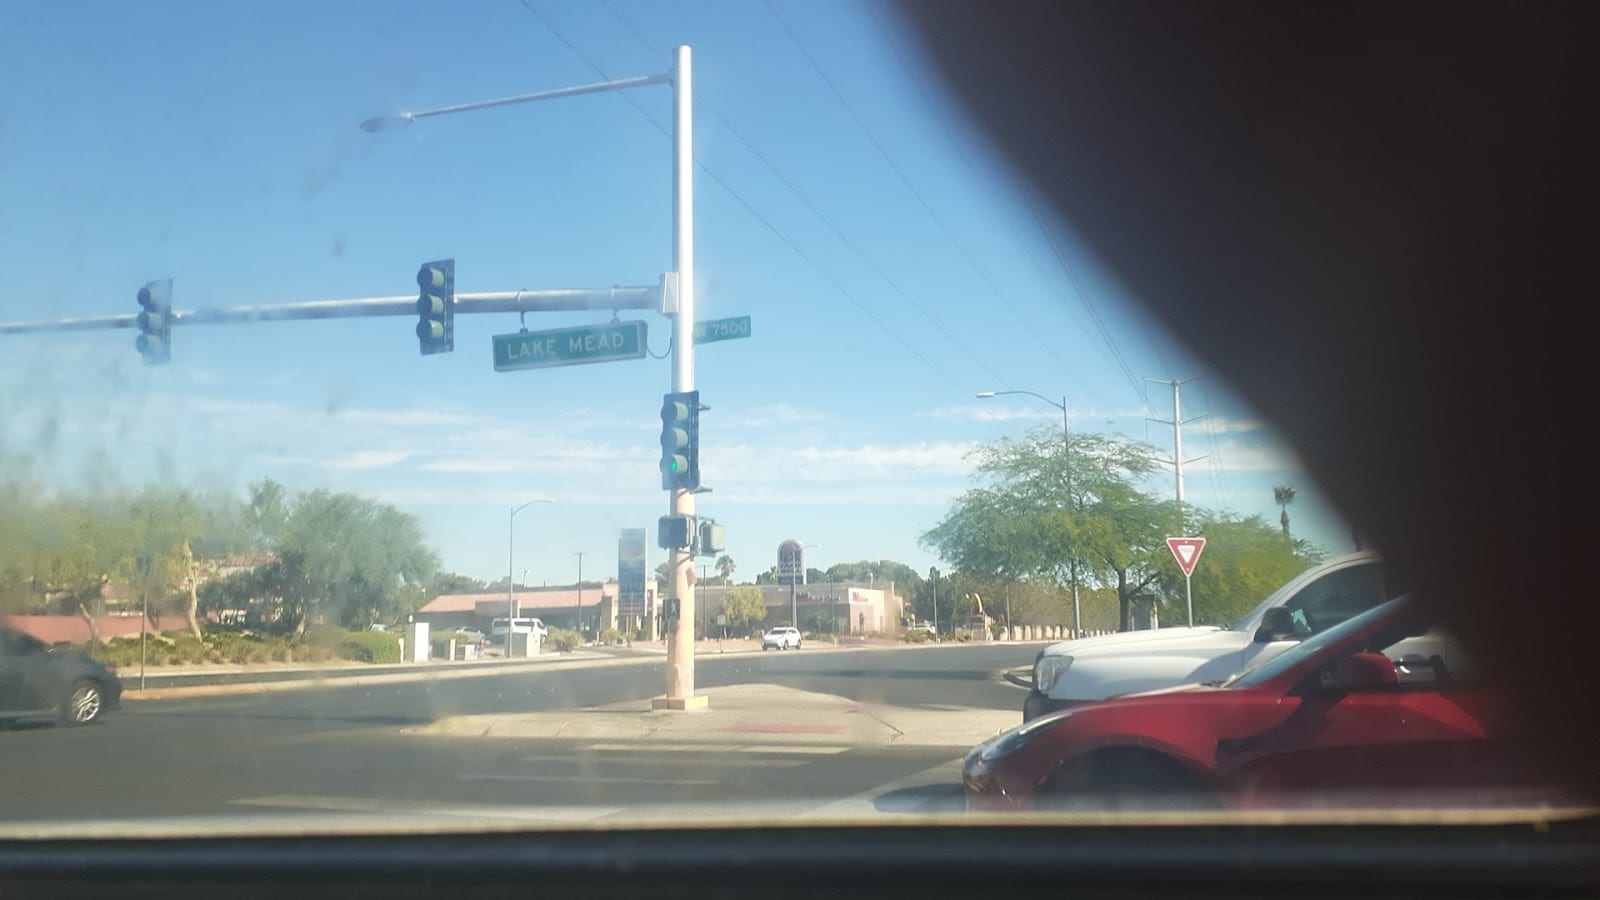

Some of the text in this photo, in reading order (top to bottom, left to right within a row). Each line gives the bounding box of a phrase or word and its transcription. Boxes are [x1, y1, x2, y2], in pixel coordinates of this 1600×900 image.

[711, 320, 748, 337] 7500
[507, 332, 625, 360] LAKE MEAD
